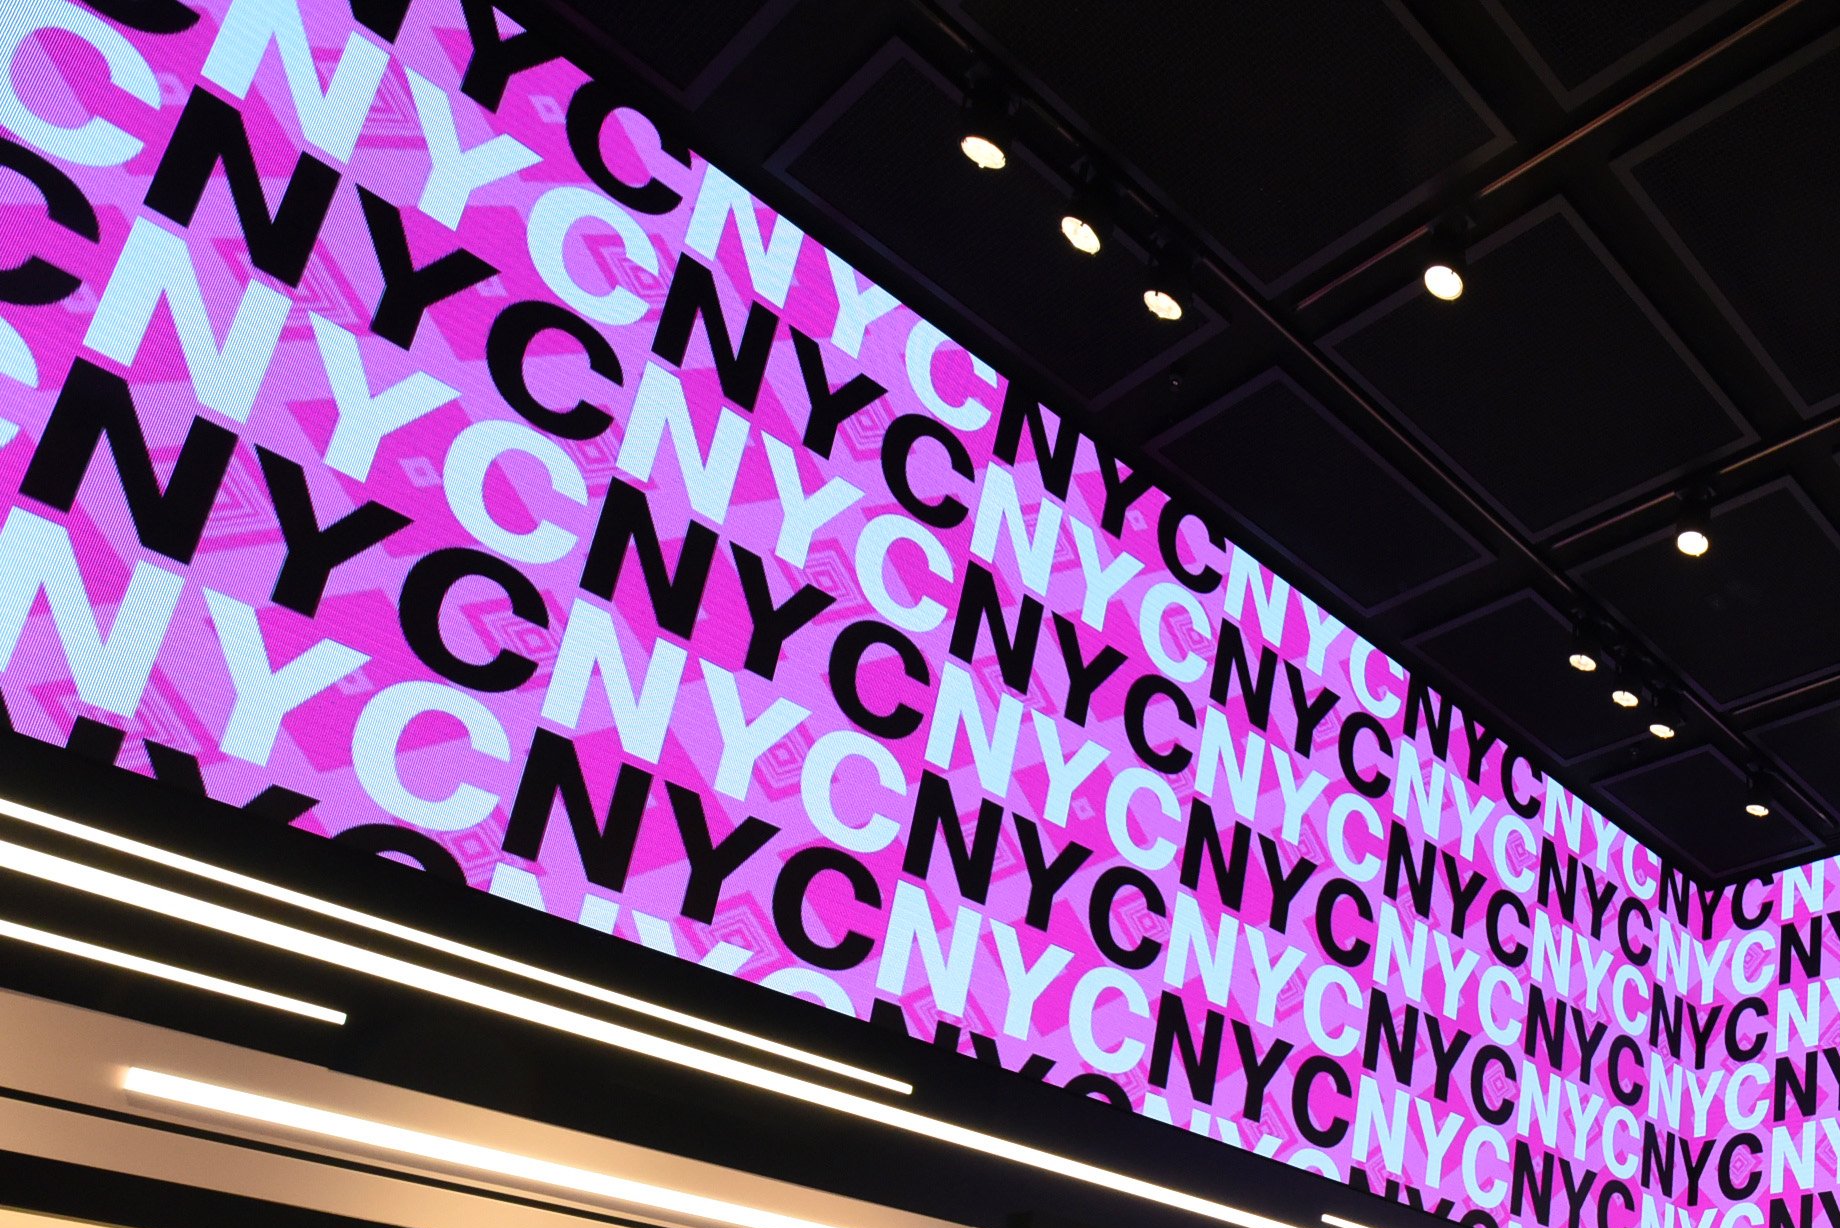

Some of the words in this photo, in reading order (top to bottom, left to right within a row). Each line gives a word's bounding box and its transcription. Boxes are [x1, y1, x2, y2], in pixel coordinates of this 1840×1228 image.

[0, 507, 510, 831] NYC
[503, 728, 881, 970] NYC
[876, 881, 1150, 1073] NYC
[1149, 992, 1351, 1147] NYC
[1352, 1076, 1509, 1208] NYC
[20, 358, 549, 692] NYC
[541, 598, 907, 852] NYC
[903, 771, 1166, 969] NYC
[1164, 892, 1363, 1056] NYC
[1363, 989, 1516, 1124] NYC
[1517, 1061, 1640, 1179] NYC
[1641, 1123, 1762, 1206] NYC
[84, 217, 588, 564] NYC
[580, 478, 930, 739] NYC
[925, 662, 1181, 870] NYC
[1180, 799, 1373, 967] NYC
[1373, 903, 1524, 1046] NYC
[1525, 986, 1643, 1105] NYC
[1648, 1053, 1770, 1137] NYC
[145, 86, 623, 440] NYC
[617, 362, 953, 632] NYC
[950, 561, 1196, 774] NYC
[1195, 707, 1383, 882] NYC
[1384, 822, 1529, 967] NYC
[1531, 910, 1648, 1036] NYC
[1650, 984, 1768, 1069] NYC
[202, 0, 658, 325] NYC
[652, 253, 974, 528] NYC
[971, 463, 1211, 683] NYC
[1210, 619, 1392, 798] NYC
[1393, 741, 1536, 893] NYC
[1538, 839, 1652, 966] NYC
[1657, 918, 1775, 1004] NYC
[685, 164, 997, 431] NYC
[993, 380, 1227, 594] NYC
[1224, 546, 1404, 719] NYC
[1402, 673, 1543, 819] NYC
[1543, 776, 1657, 899] NYC
[1658, 858, 1774, 940] NYC
